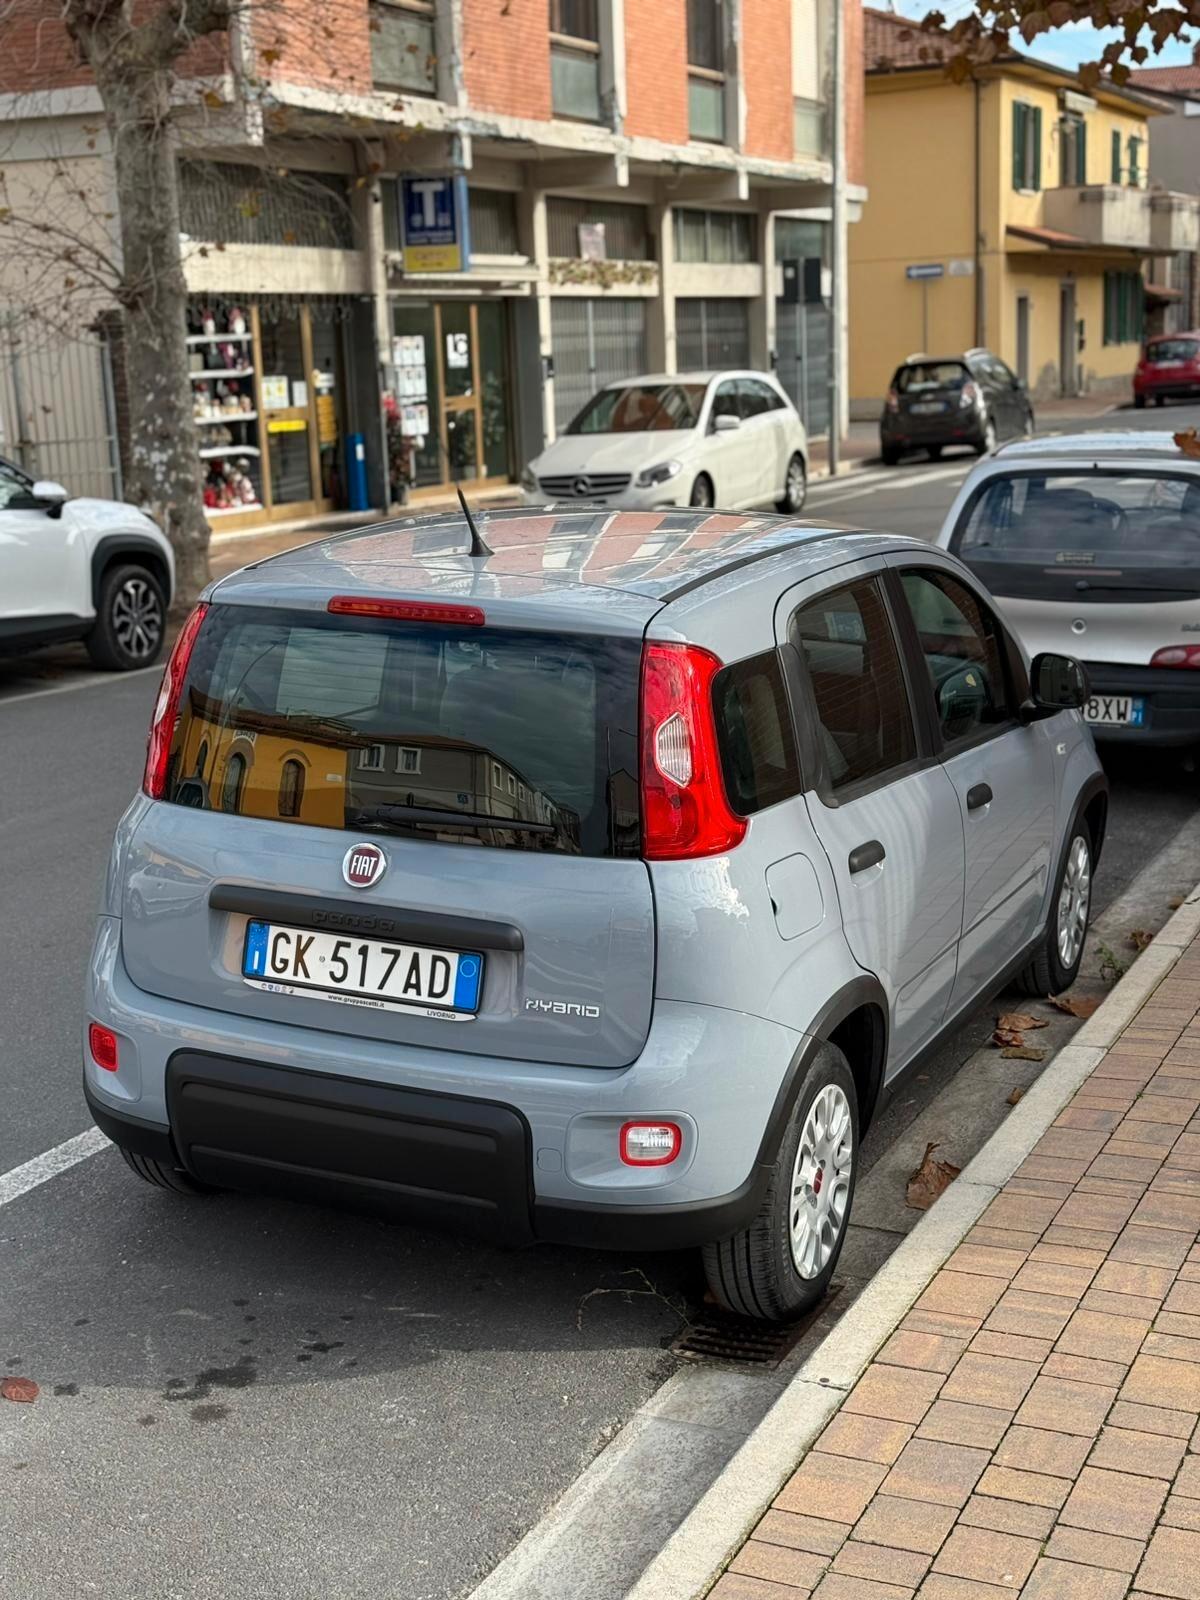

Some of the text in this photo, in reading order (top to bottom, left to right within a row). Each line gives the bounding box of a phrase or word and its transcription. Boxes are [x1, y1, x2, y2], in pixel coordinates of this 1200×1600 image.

[411, 182, 444, 227] T
[1082, 698, 1128, 721] 8XW
[350, 855, 377, 877] FIAT
[312, 910, 396, 932] panda
[270, 931, 451, 999] GK 517AD
[426, 1009, 456, 1020] LIVORNO
[525, 998, 600, 1018] HYBRID
